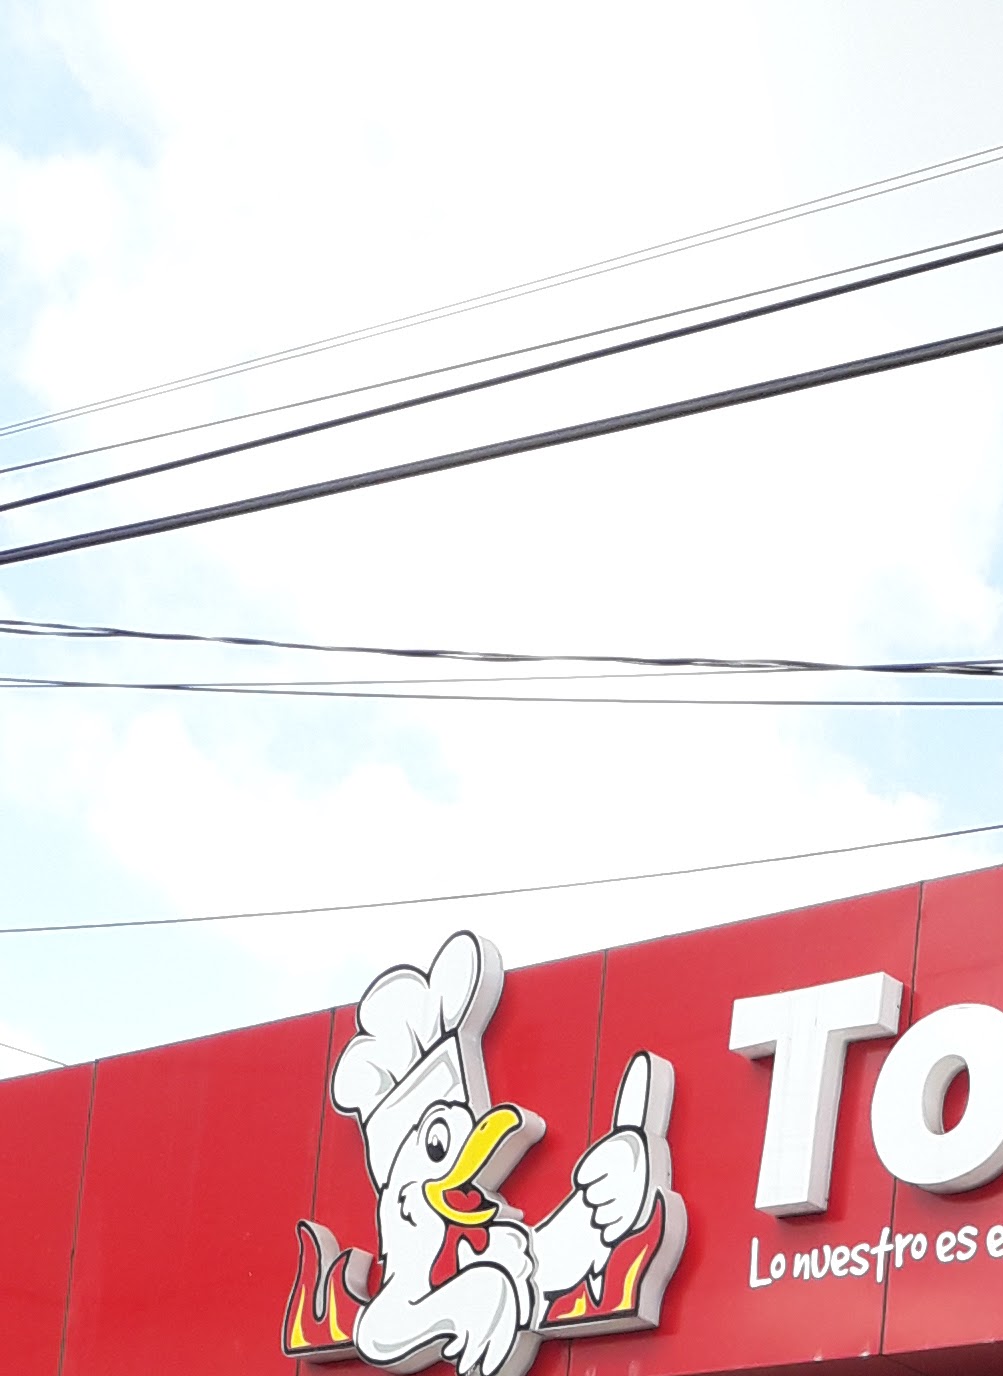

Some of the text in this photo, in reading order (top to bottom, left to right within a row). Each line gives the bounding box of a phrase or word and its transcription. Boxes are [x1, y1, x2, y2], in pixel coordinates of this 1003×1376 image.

[749, 1237, 786, 1288] Lo
[793, 1226, 928, 1283] nuestro
[935, 1224, 979, 1263] es
